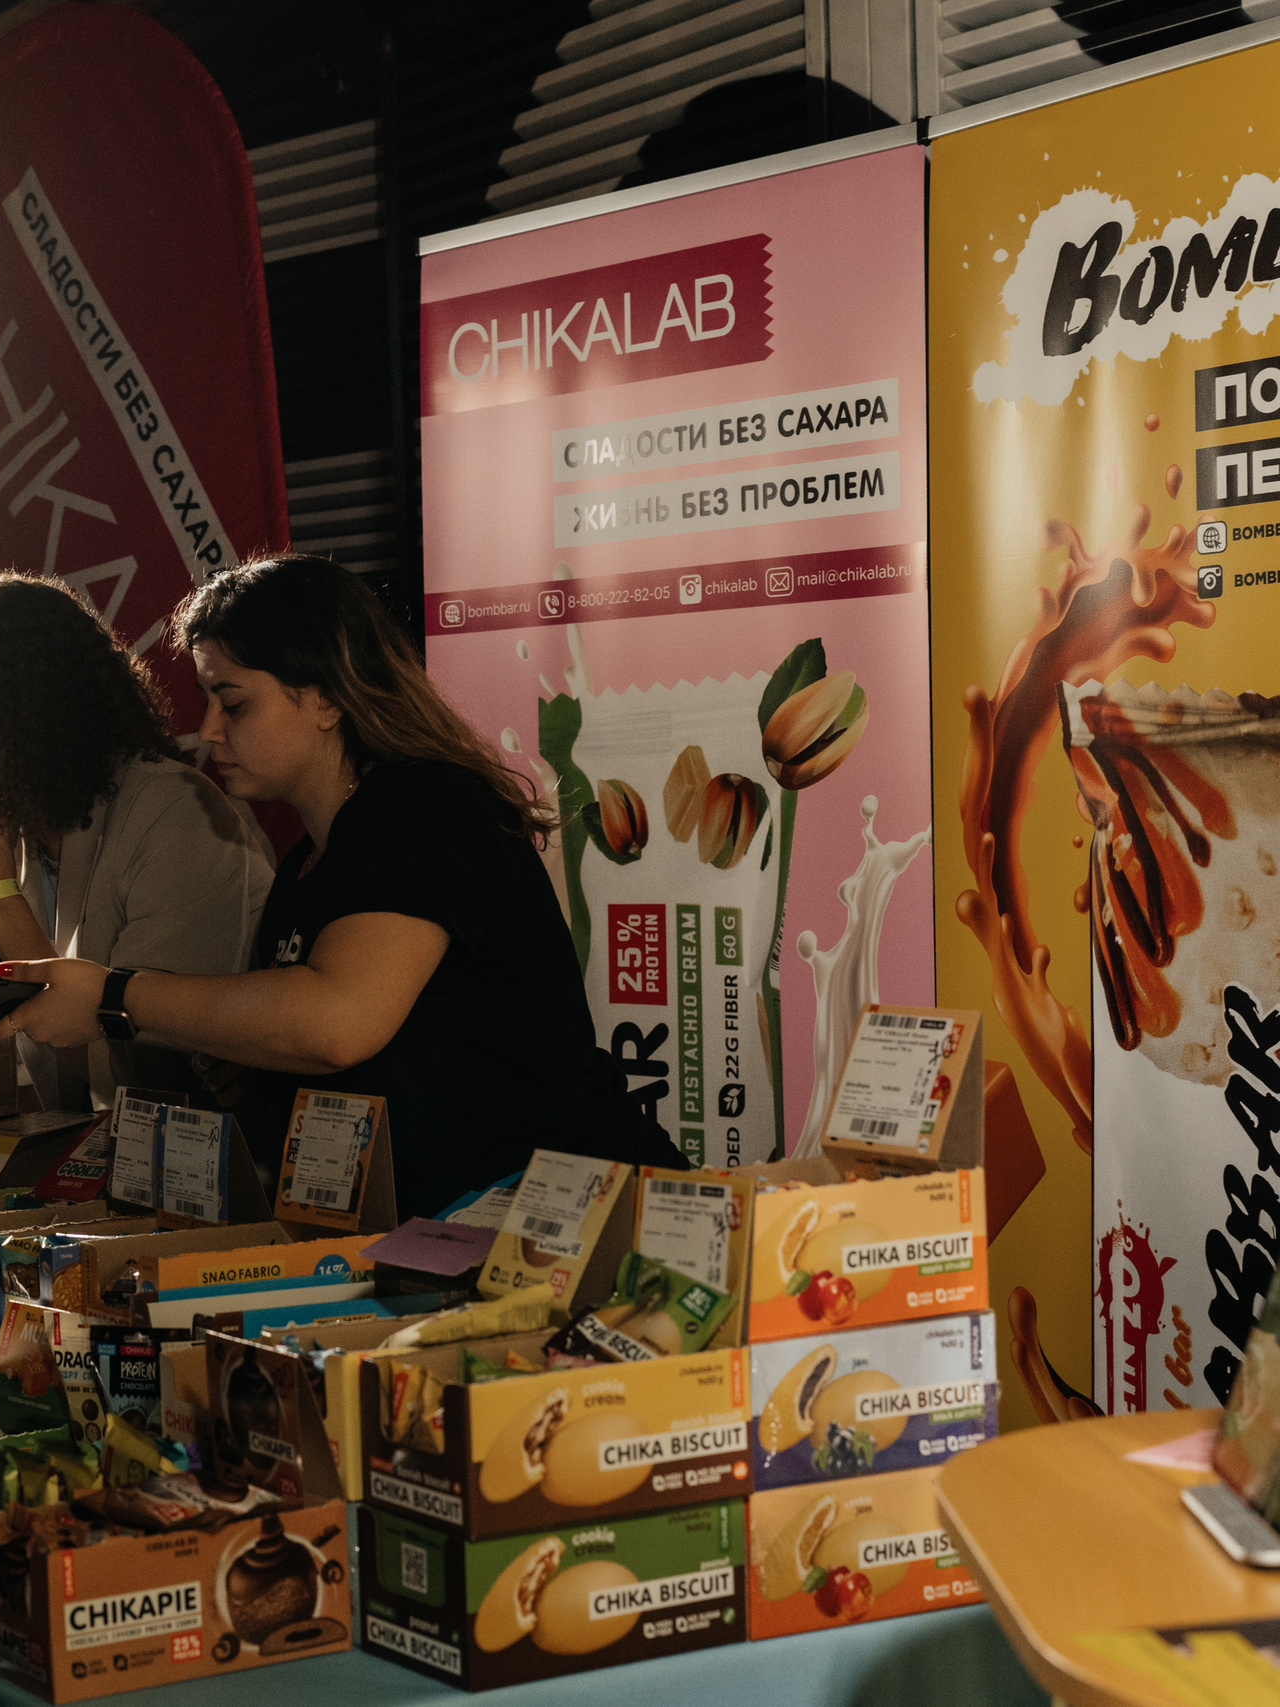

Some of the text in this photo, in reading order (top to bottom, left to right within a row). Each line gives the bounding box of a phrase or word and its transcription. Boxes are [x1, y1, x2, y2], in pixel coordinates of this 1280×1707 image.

[448, 273, 737, 384] CHIKALAB
[21, 192, 228, 576] СЛАДОСТИ БЕЗ САХАР
[563, 394, 890, 469] СЛАДОСТИ БЕЗ САХАРА
[572, 466, 885, 533] ЖИЗНЬ БЕЗ ПРОБЛЕМ
[705, 576, 758, 596] chikalab
[797, 562, 913, 588] mail@chikalab.ru
[467, 600, 531, 620] bombbar.ru
[567, 586, 671, 609] 8-800-222-82-05
[617, 914, 643, 993] 25%
[645, 914, 660, 993] PROTEIN
[682, 912, 697, 984] CREAM
[723, 915, 737, 960] 60 G
[724, 974, 740, 1080] 22G FIBER
[683, 994, 699, 1114] PISTACHIO
[57, 1161, 107, 1180] COOKIE
[846, 1237, 969, 1269] CHIKA BISCUIT
[202, 1264, 281, 1285] SNAQ FABRIQ
[120, 1360, 157, 1379] PROTEIN
[860, 1383, 981, 1417] CHIKA BISCUIT
[604, 1427, 742, 1465] CHIKA BISCUIT
[372, 1477, 460, 1522] CHIKA BISCUIT
[571, 1527, 616, 1547] cookie
[863, 1538, 917, 1564] CHIKA
[70, 1587, 197, 1631] CHIKAPIE
[594, 1573, 730, 1614] CHIKA BISCUIT
[370, 1621, 459, 1670] CHIKA BISCUIT
